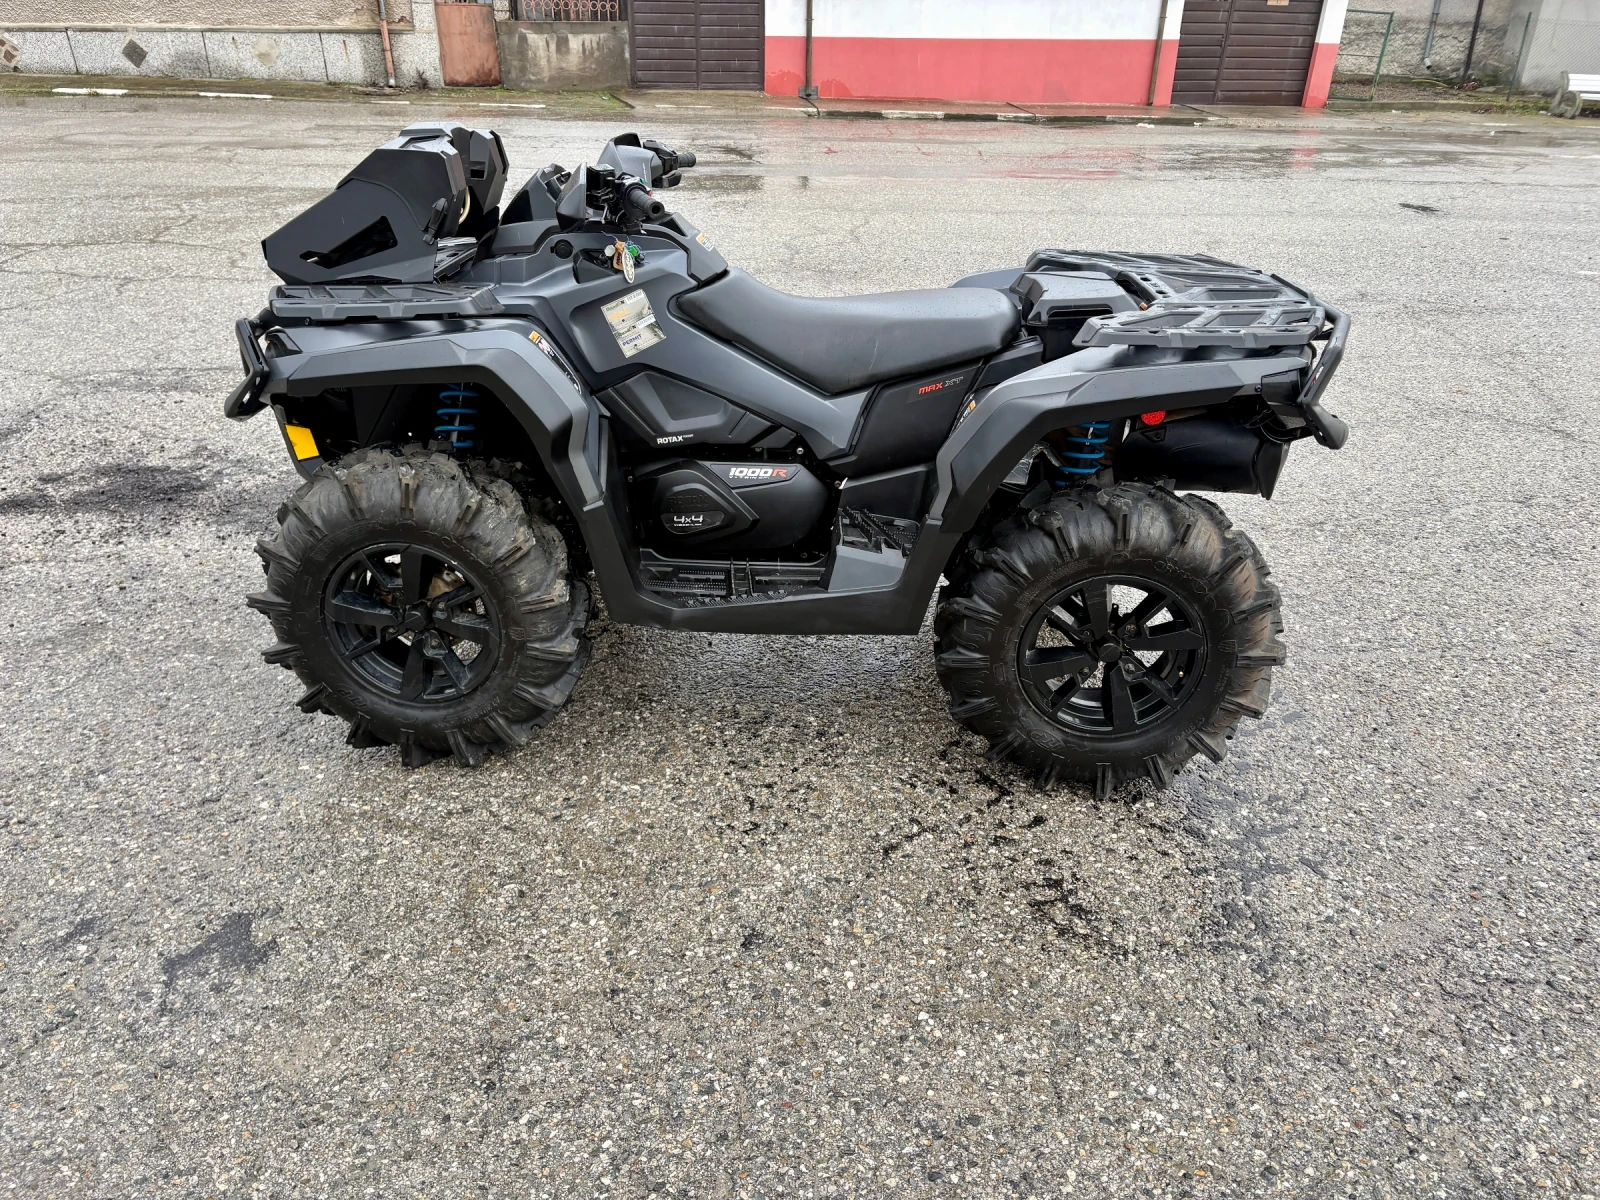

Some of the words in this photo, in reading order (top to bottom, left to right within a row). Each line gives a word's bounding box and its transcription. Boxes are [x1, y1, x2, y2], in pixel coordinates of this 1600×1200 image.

[622, 333, 642, 346] PERMIT
[918, 381, 943, 395] MAX
[656, 435, 684, 445] ROTAX
[728, 467, 788, 478] 1000R
[673, 514, 704, 524] 4x4
